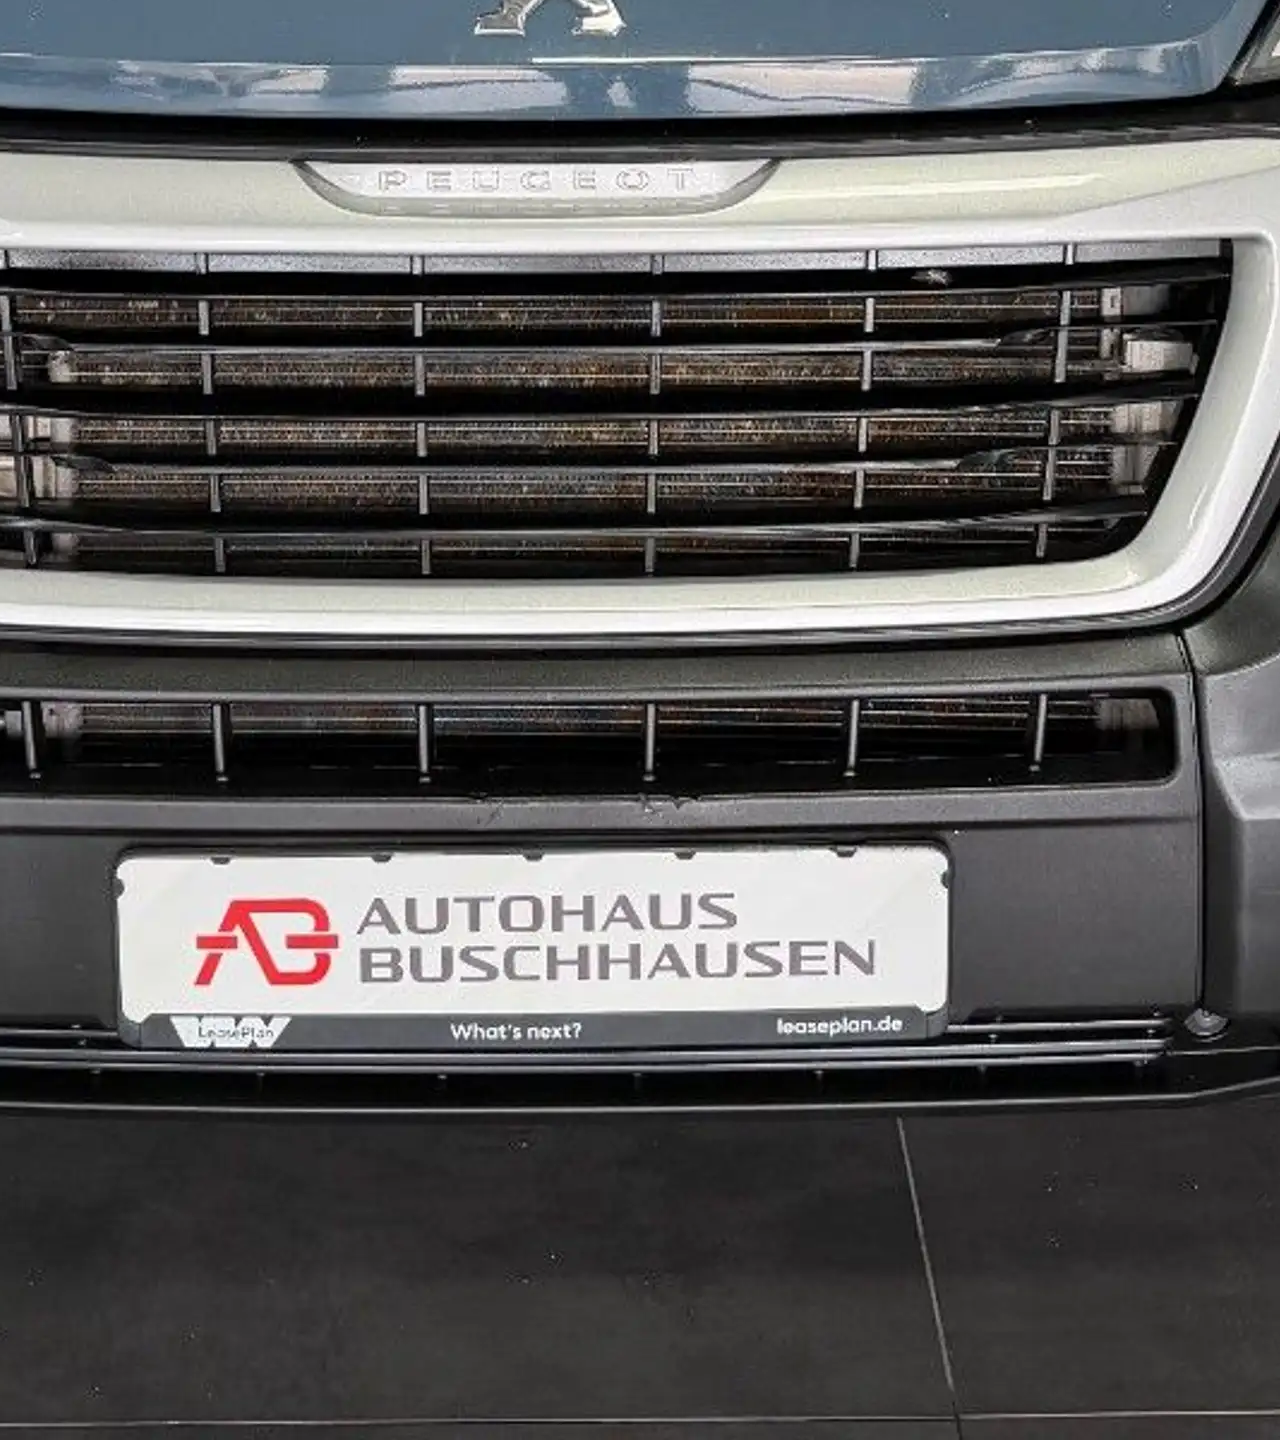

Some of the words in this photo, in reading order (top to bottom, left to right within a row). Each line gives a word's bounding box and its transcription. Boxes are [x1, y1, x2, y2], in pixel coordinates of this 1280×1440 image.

[378, 166, 695, 192] PEUGEOT
[358, 892, 738, 935] AUTOHAUS
[359, 939, 876, 983] BUSCHHAUSEN
[450, 1022, 521, 1041] What's
[526, 1022, 583, 1040] next?
[776, 1016, 903, 1038] leaseplan.de
